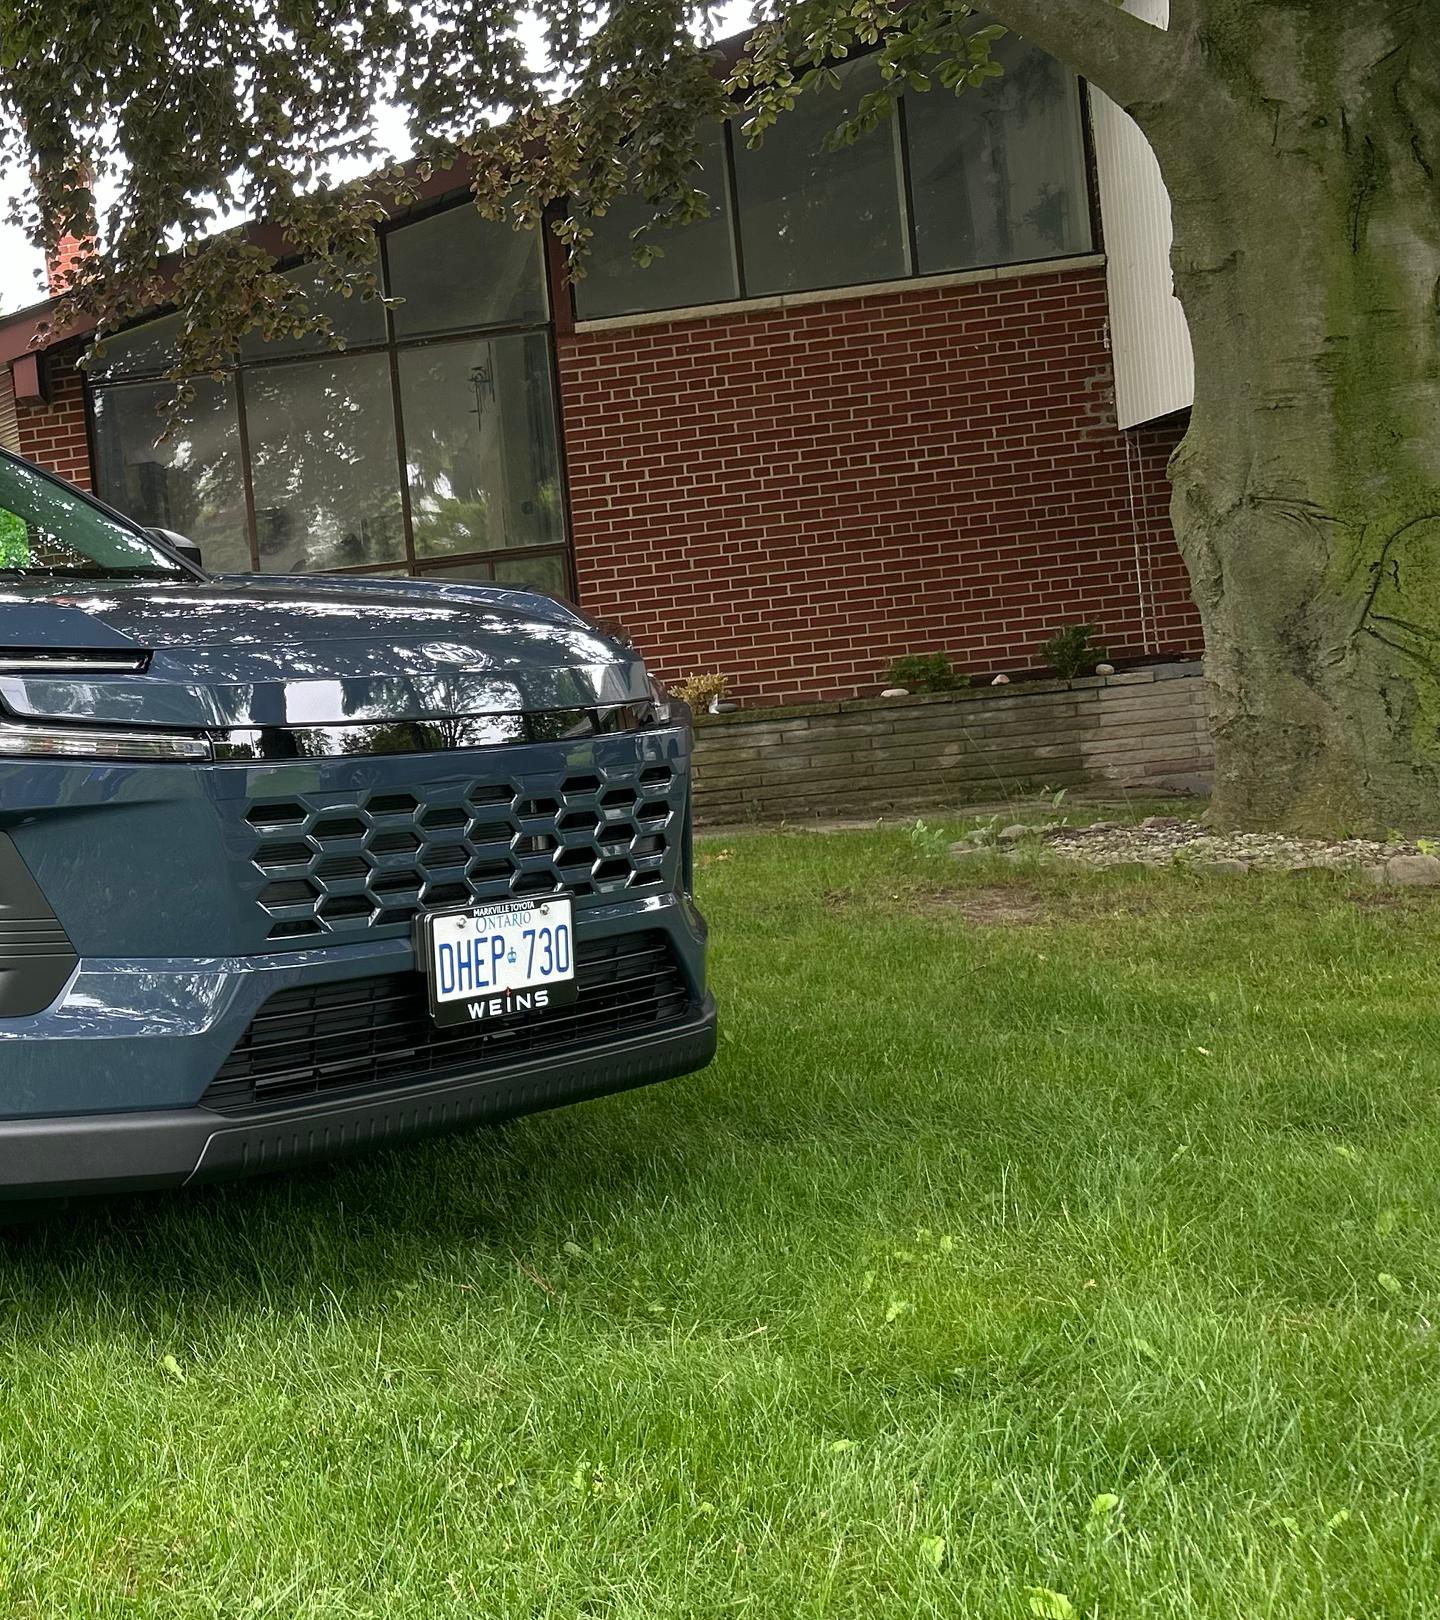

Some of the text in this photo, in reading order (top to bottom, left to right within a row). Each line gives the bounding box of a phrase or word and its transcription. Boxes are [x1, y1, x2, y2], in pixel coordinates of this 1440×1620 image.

[473, 901, 535, 917] MARKVILLE TOYOTA
[476, 912, 532, 933] ONTARIO
[439, 924, 570, 994] DHEP 730
[468, 990, 549, 1020] WEINS
